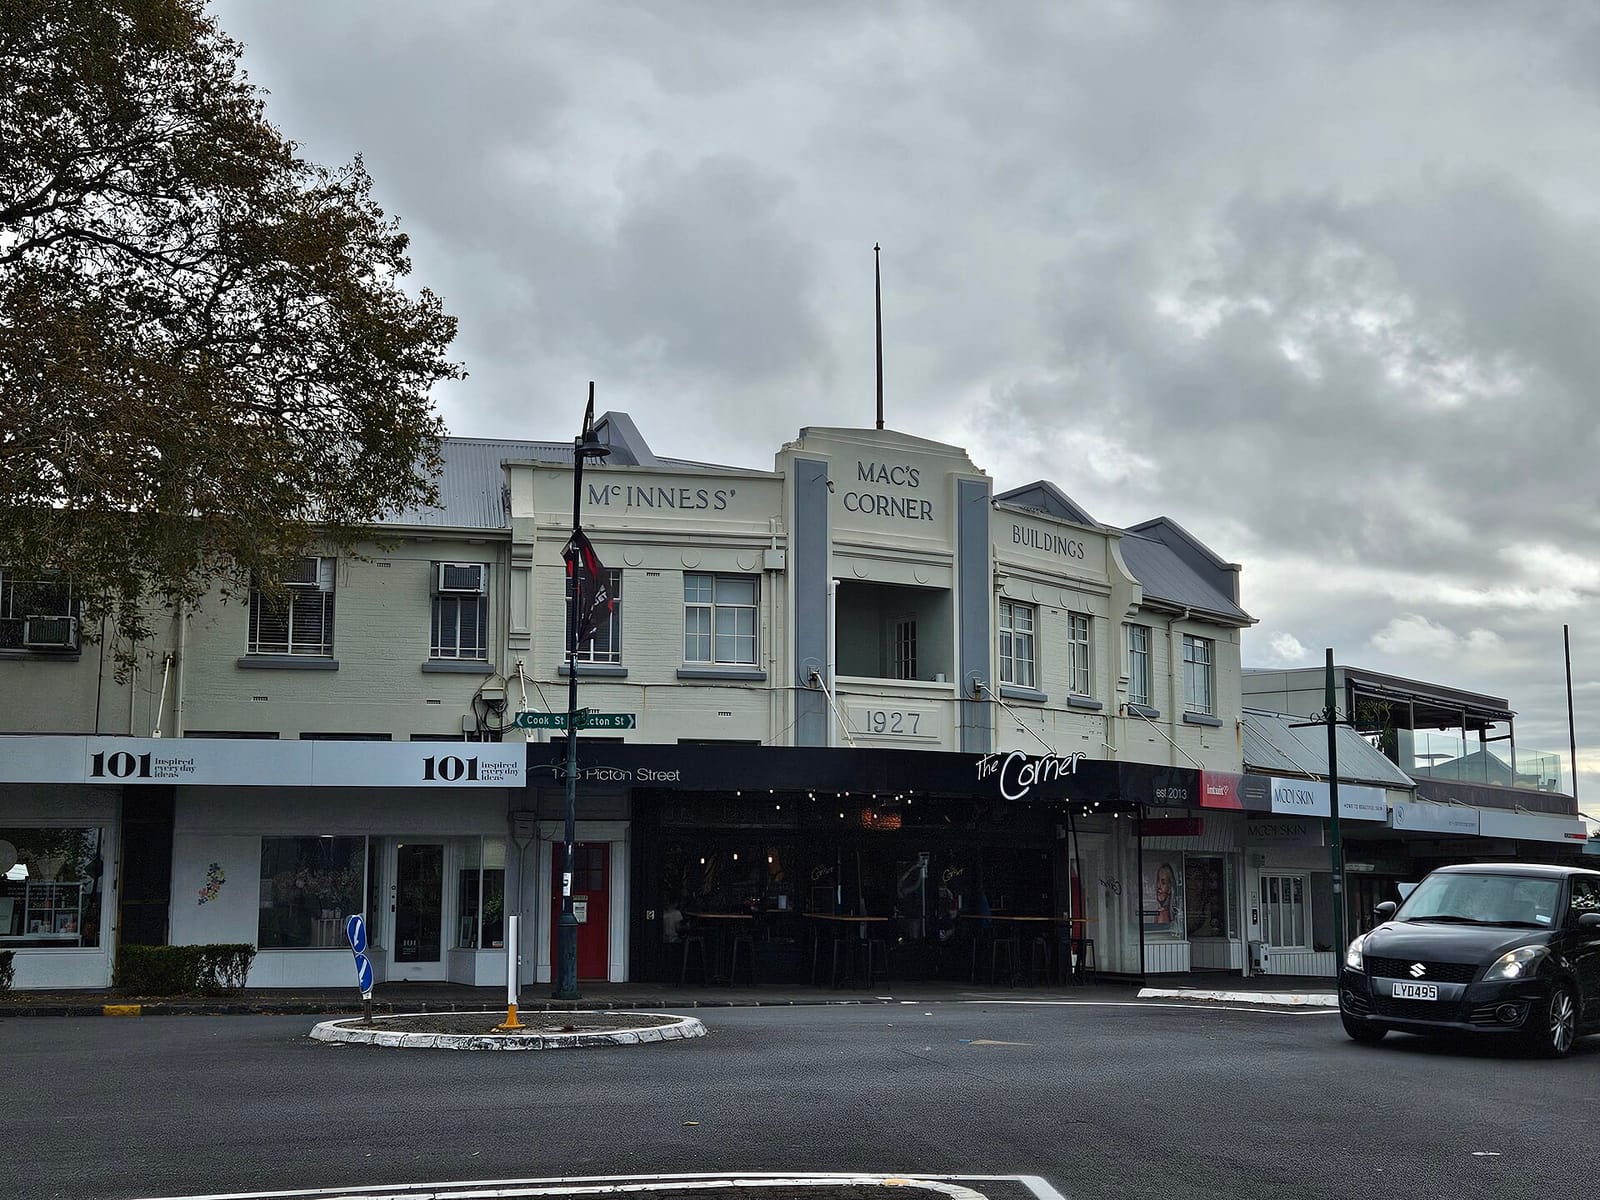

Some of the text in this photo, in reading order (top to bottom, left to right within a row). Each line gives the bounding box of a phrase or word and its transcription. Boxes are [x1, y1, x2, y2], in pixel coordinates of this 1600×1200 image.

[857, 461, 920, 488] MAC'S
[843, 492, 934, 521] CORNER
[1012, 524, 1085, 560] BUILDINGS
[526, 715, 565, 726] Cook St
[614, 716, 625, 727] St
[867, 710, 920, 734] 1927
[90, 751, 153, 778] 101
[154, 758, 194, 767] inspired
[422, 755, 480, 781] 101
[481, 761, 518, 770] inspired
[586, 767, 632, 781] Picton
[636, 768, 681, 782] Street
[975, 751, 1086, 800] The Corner
[1155, 788, 1188, 800] est 2013
[1295, 790, 1314, 805] SKIN
[1279, 824, 1307, 836] SKIN
